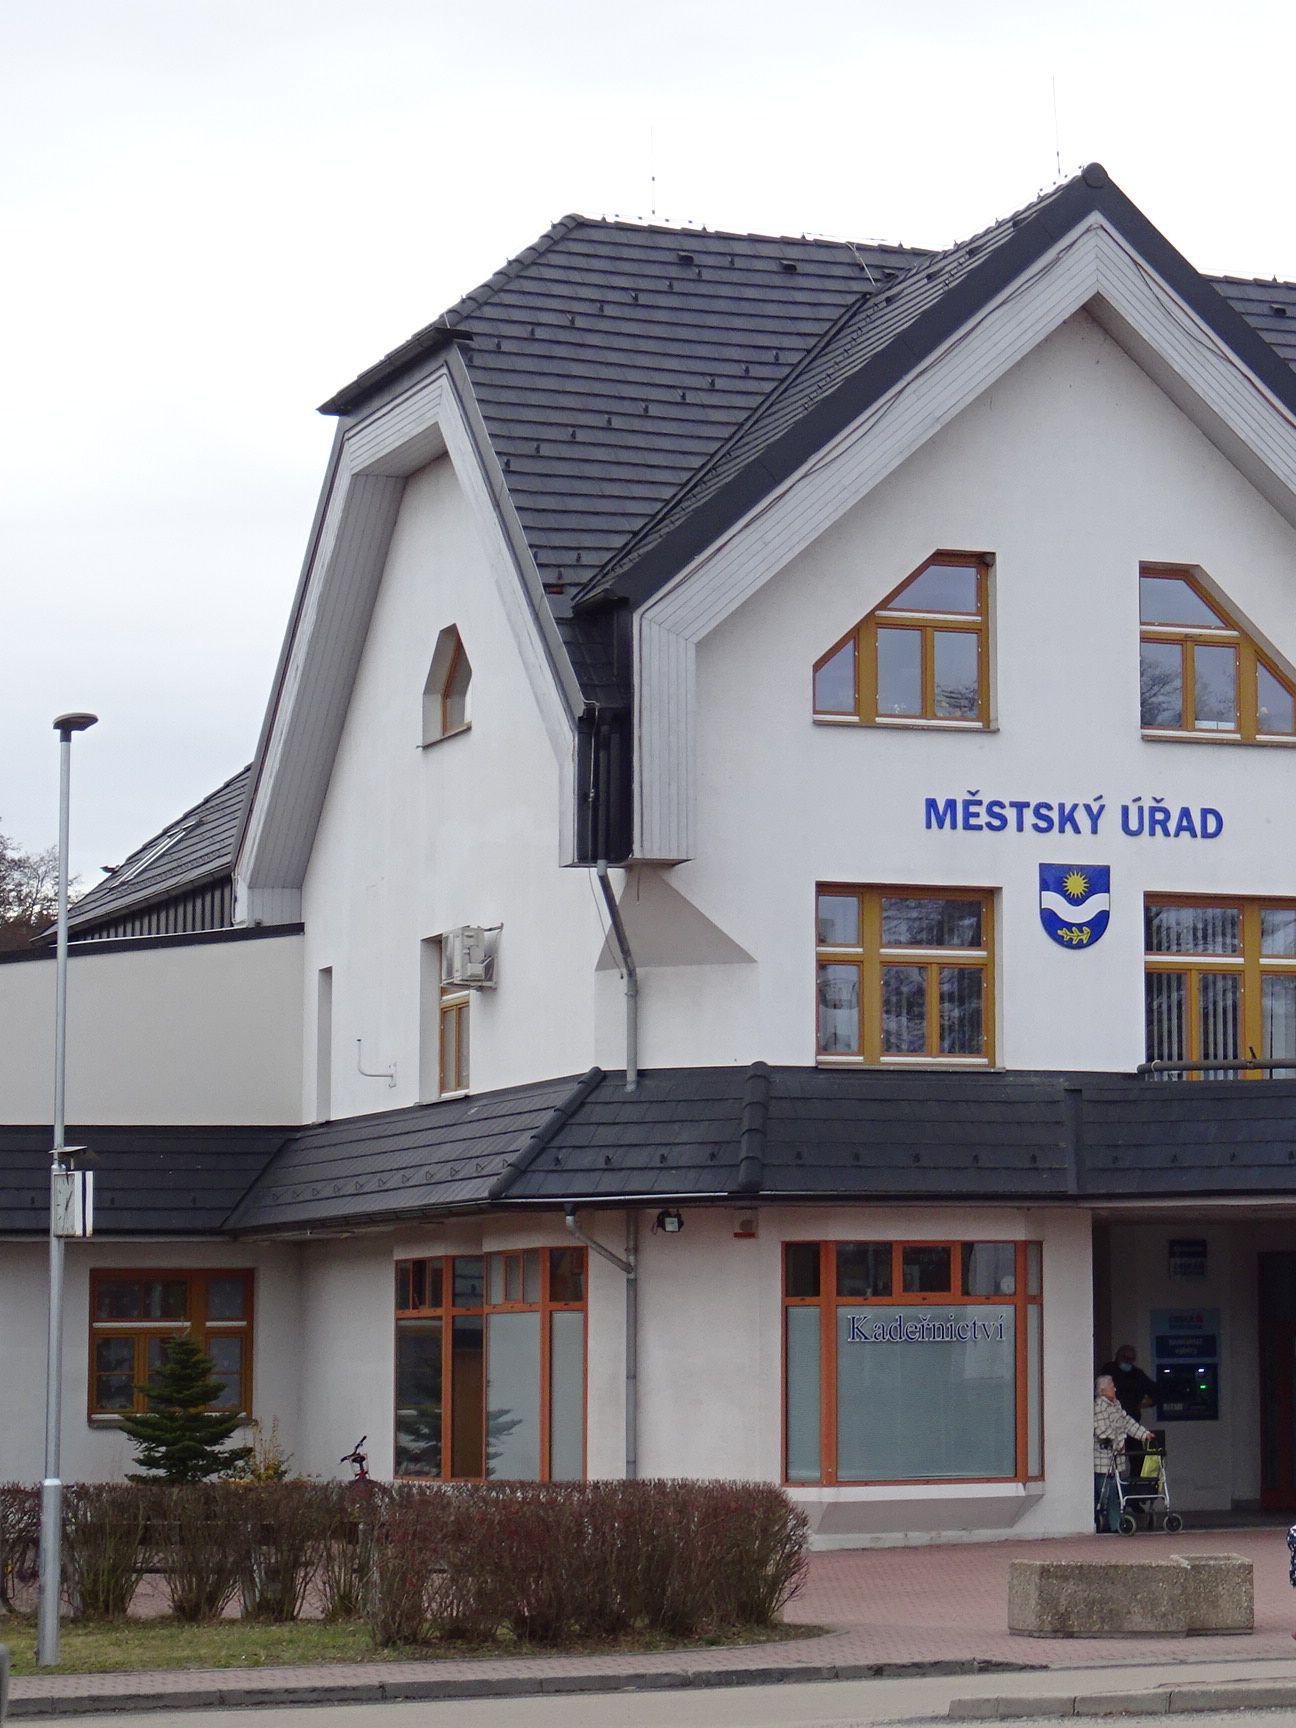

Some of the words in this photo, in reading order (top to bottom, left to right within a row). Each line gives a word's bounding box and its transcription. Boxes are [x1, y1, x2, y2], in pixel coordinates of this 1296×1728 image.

[924, 789, 1106, 835] MĚSTSKÝ
[1121, 796, 1224, 839] ÚŘAD
[847, 1313, 1007, 1343] Kadeřnictví
